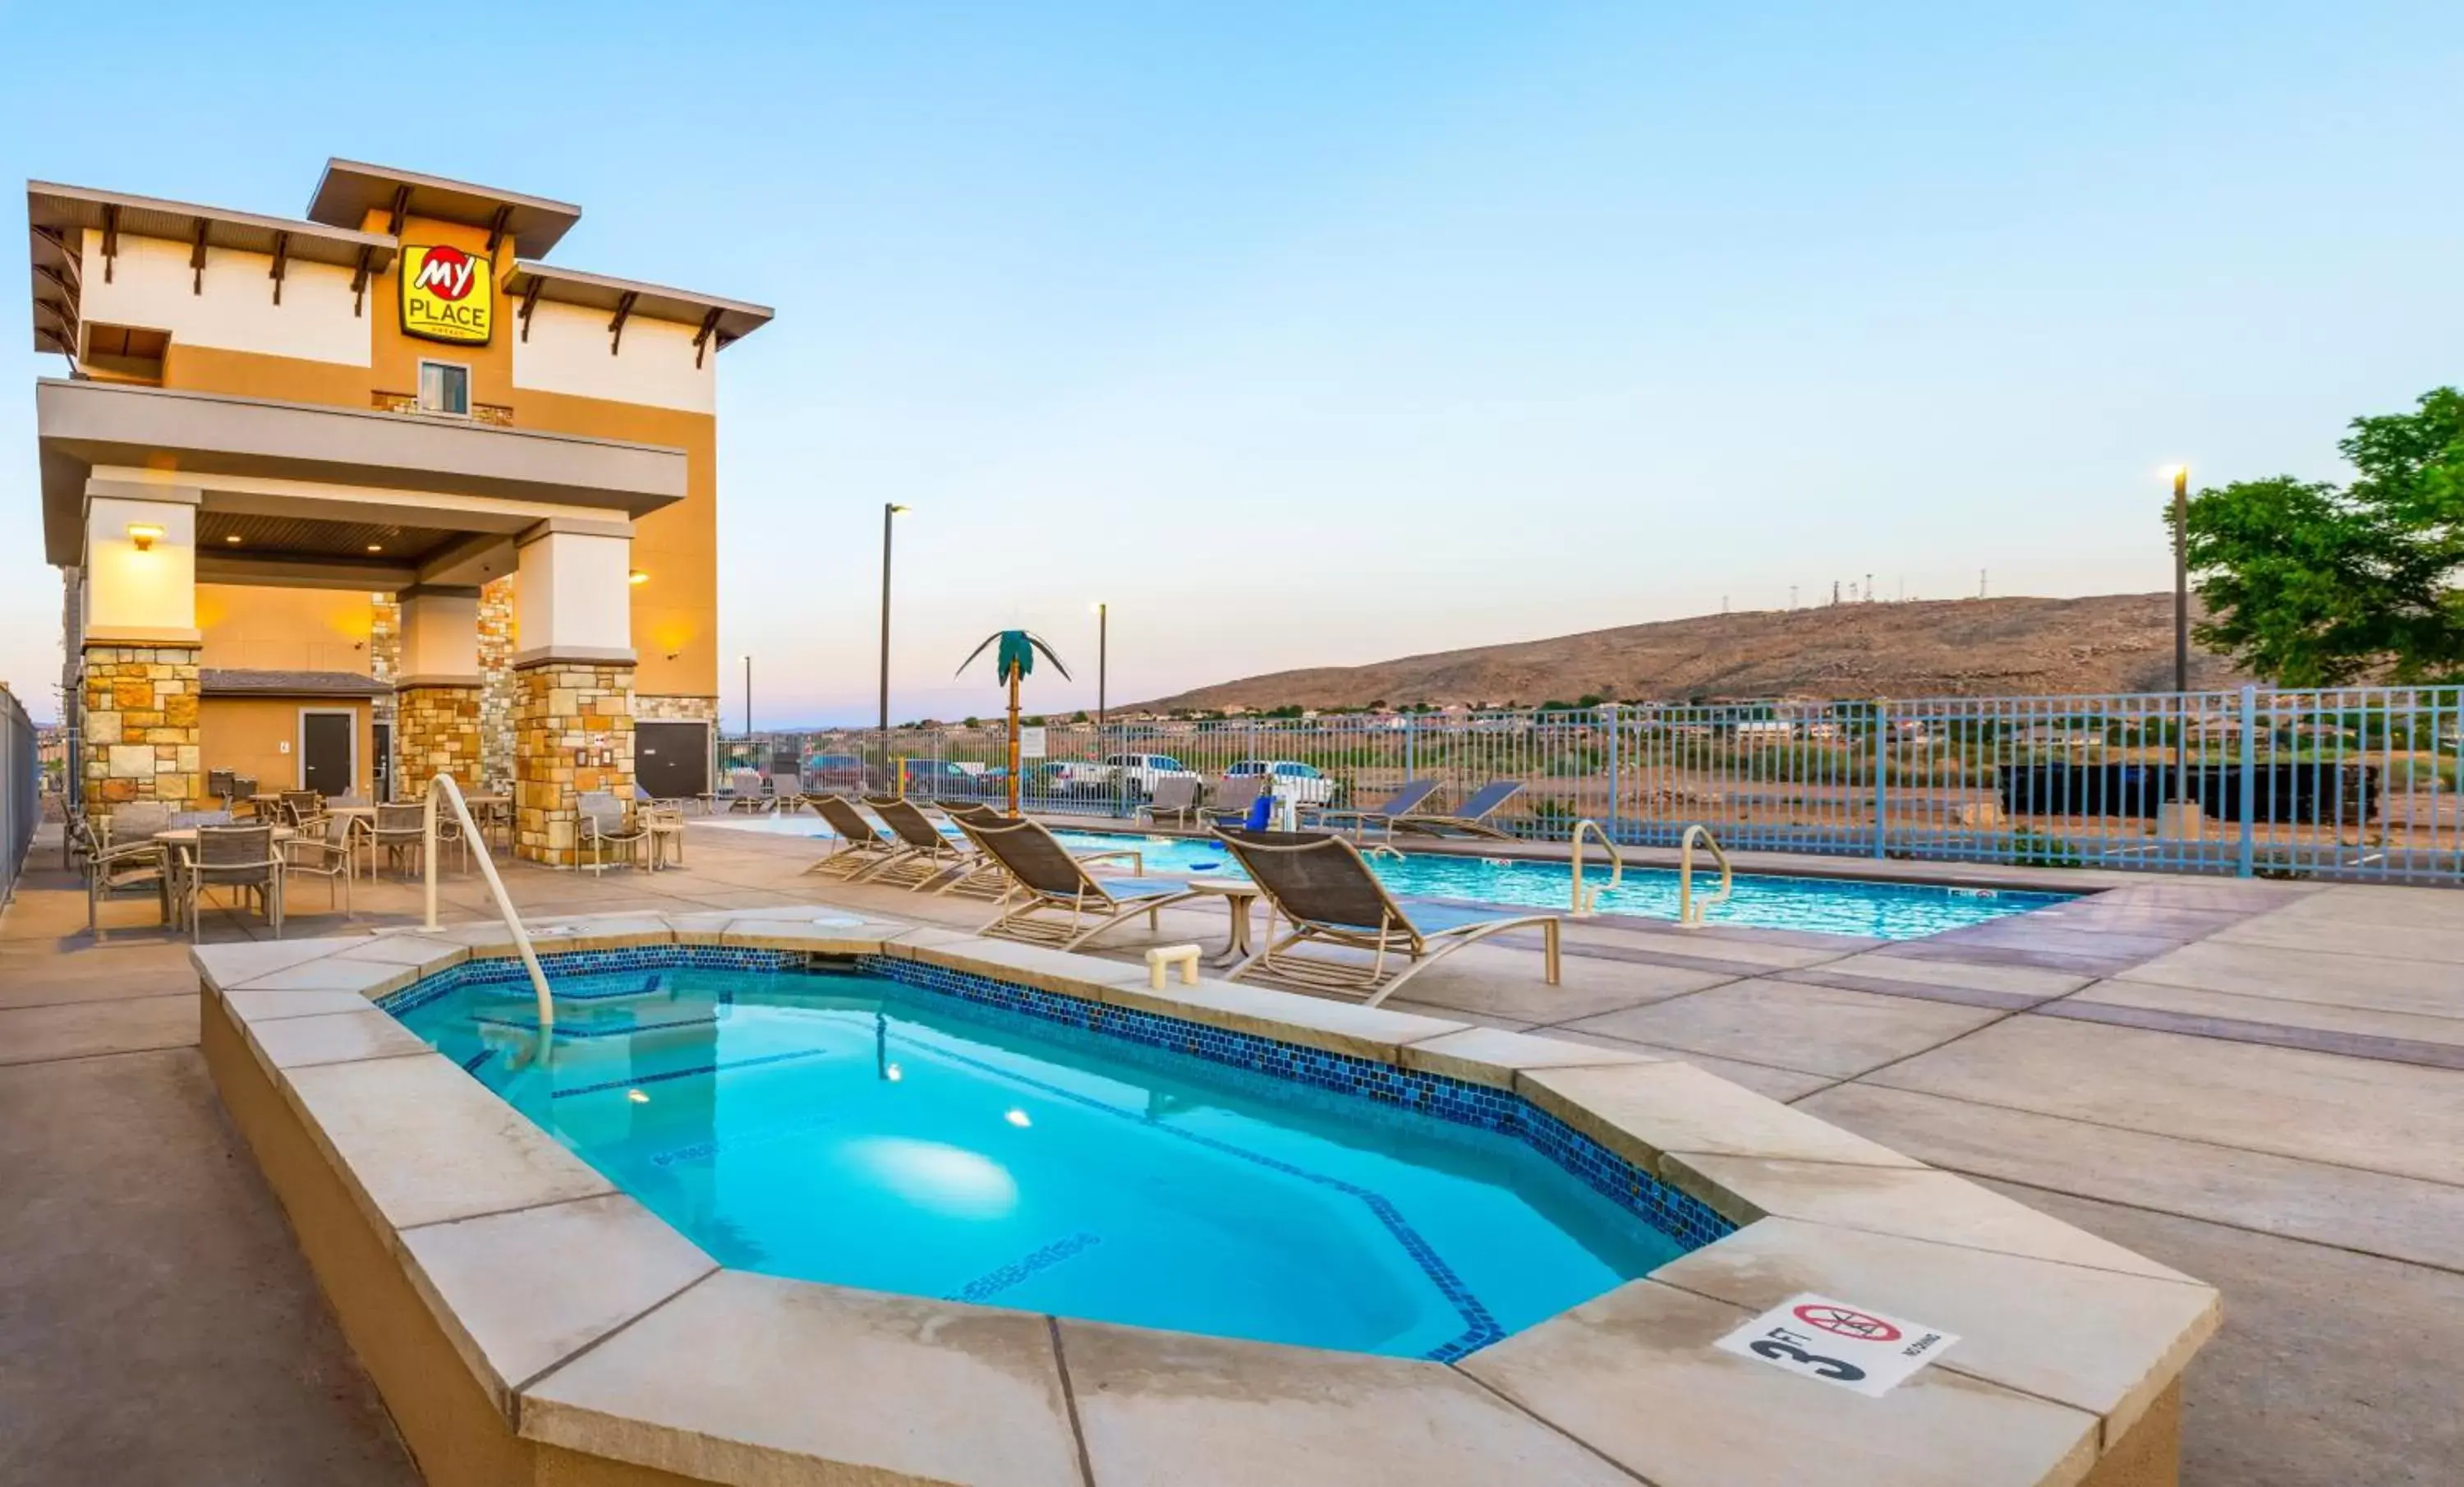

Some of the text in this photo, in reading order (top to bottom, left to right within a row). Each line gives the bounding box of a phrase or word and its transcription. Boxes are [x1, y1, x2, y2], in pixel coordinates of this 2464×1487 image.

[410, 298, 485, 327] PLACE
[1749, 1327, 1866, 1381] 3 FT
